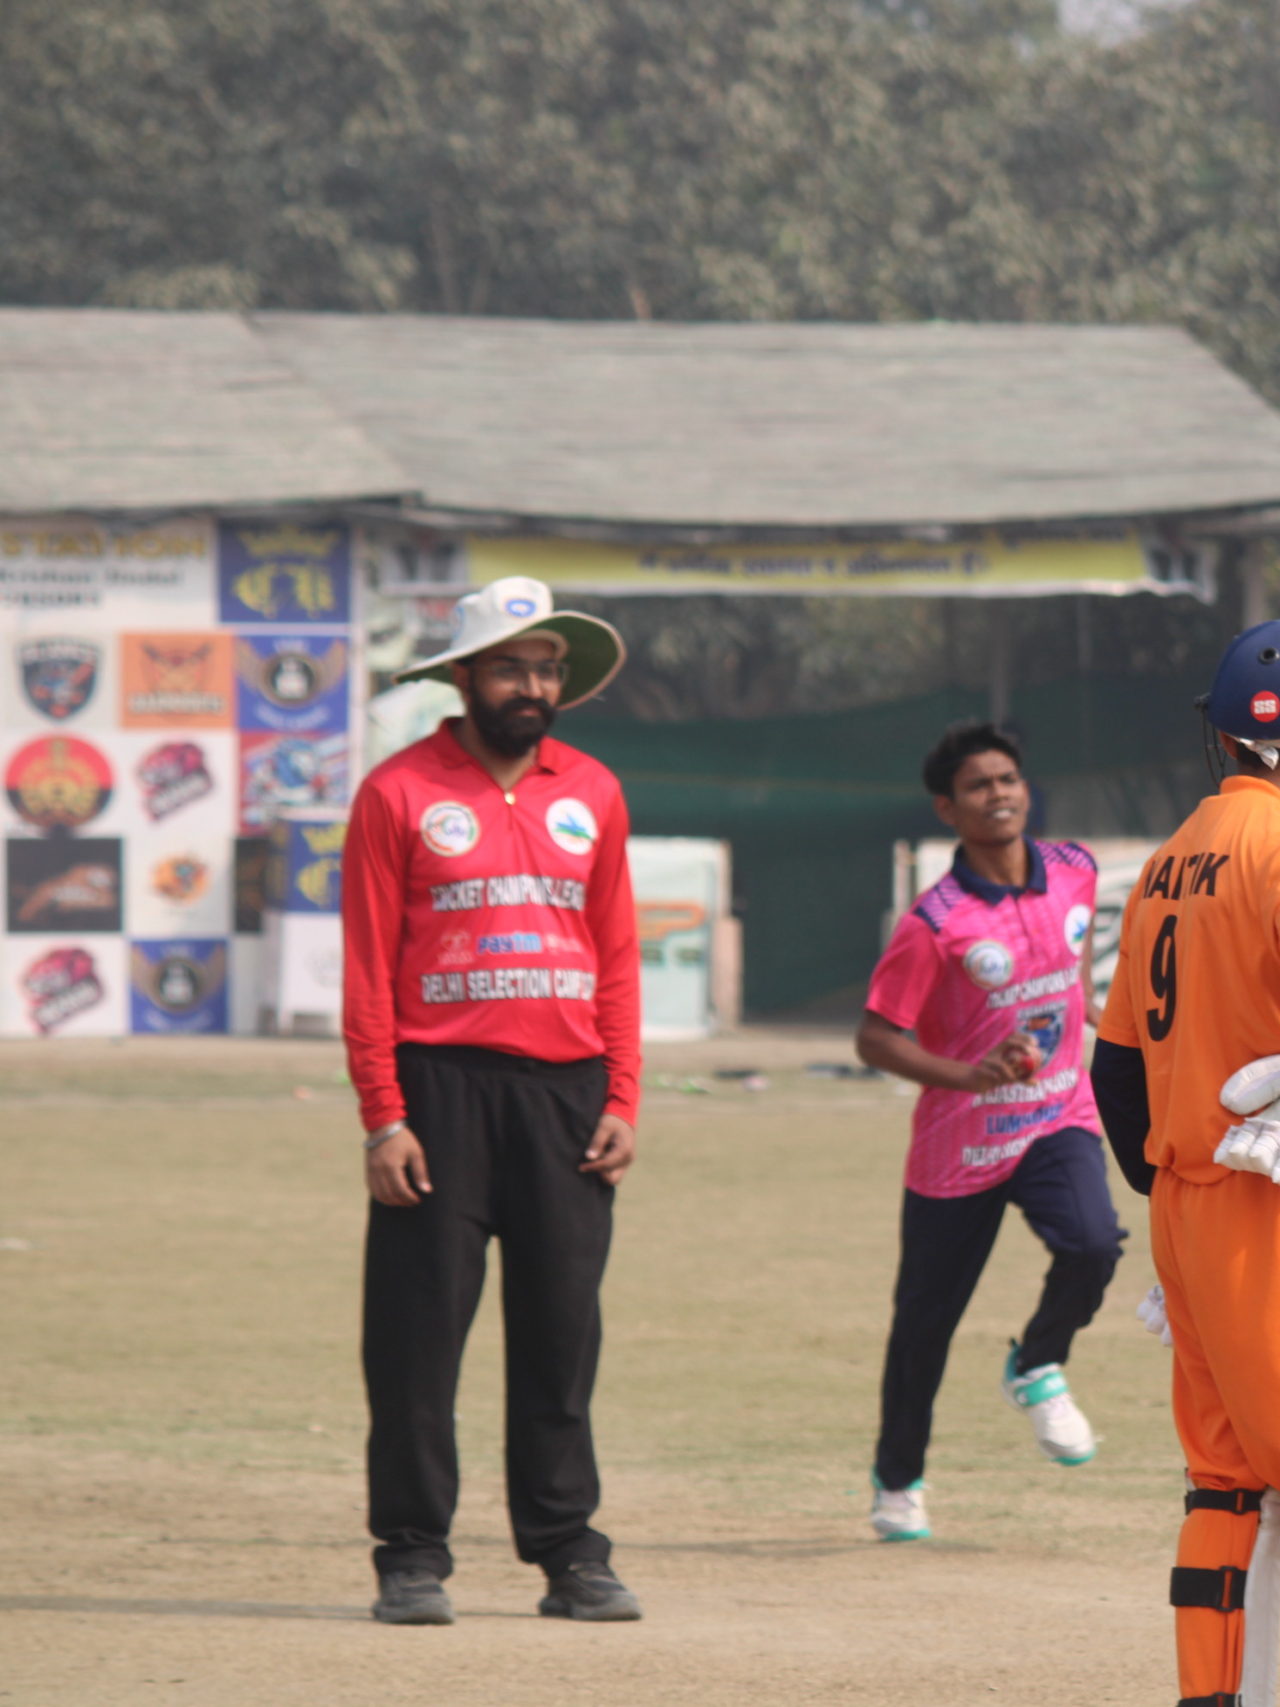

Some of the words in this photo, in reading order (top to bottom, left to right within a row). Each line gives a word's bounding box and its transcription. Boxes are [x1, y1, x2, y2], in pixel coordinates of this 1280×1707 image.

[1254, 700, 1276, 714] SS
[467, 968, 552, 1000] SELECTION
[1147, 915, 1178, 1041] 9
